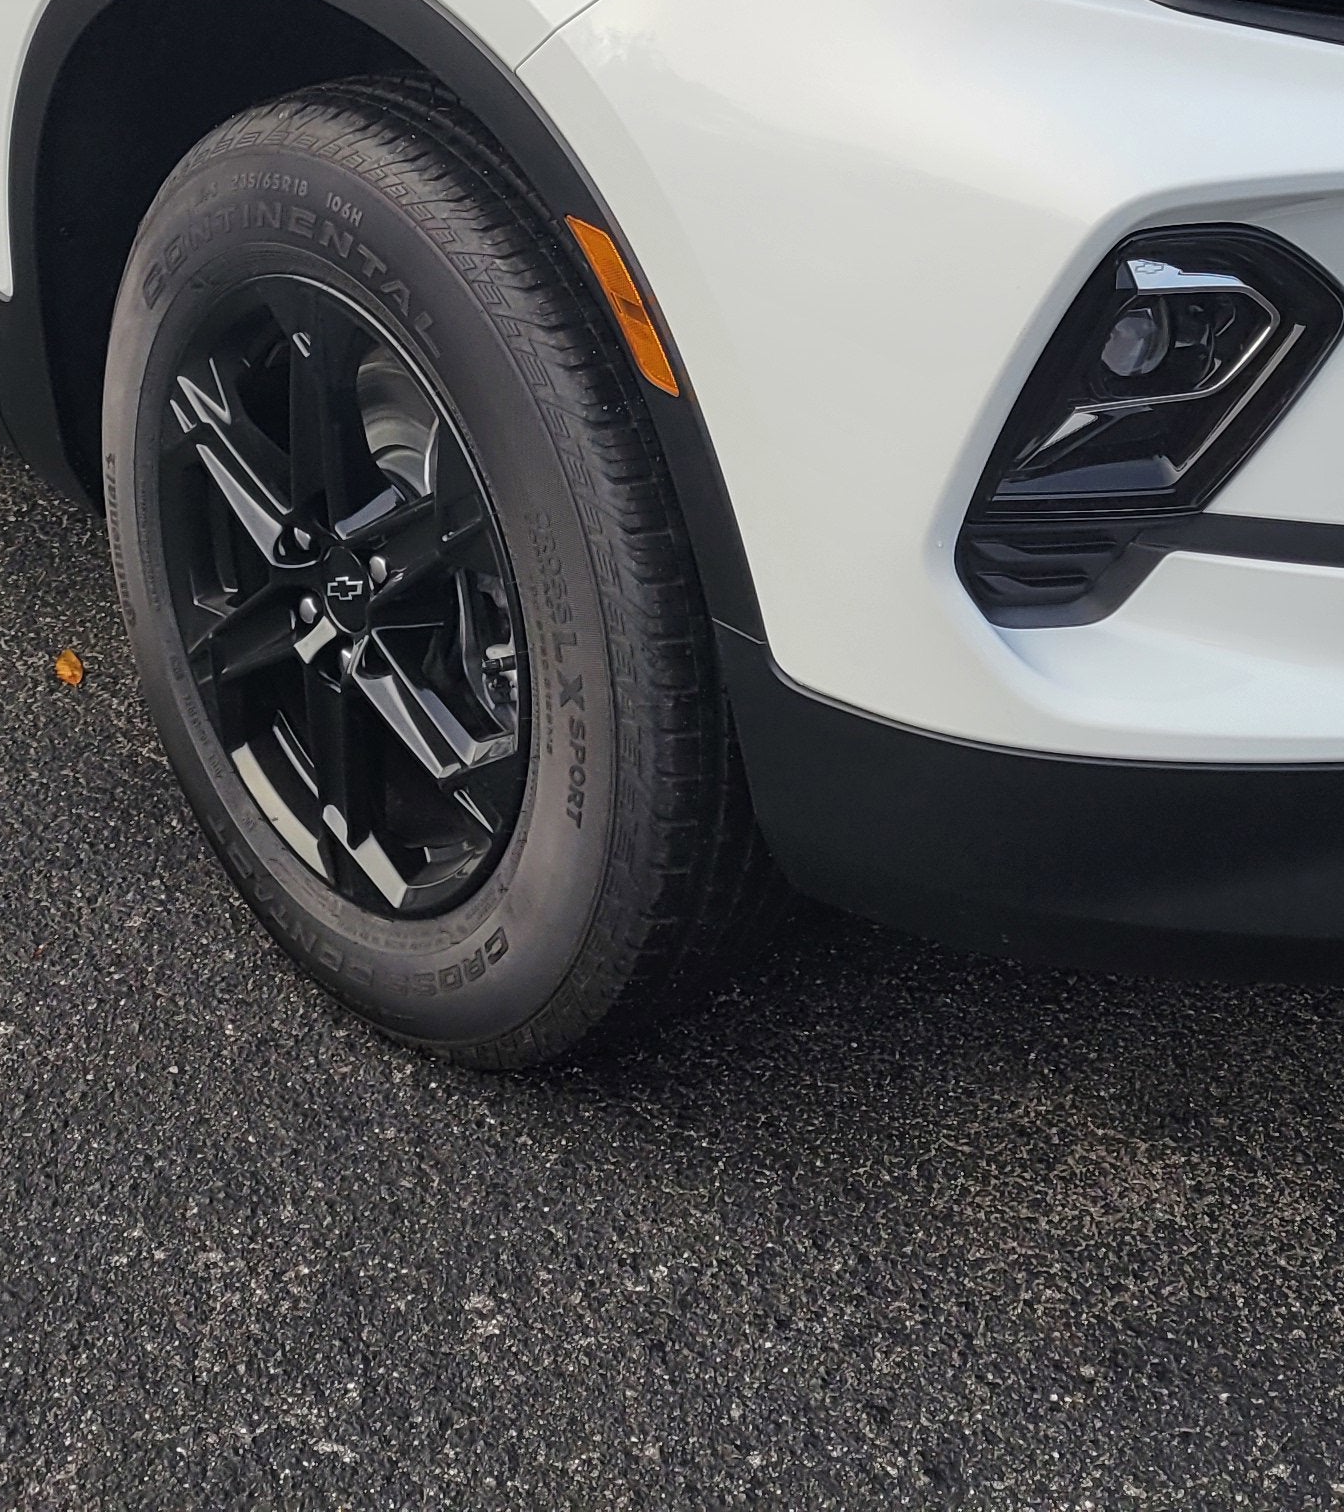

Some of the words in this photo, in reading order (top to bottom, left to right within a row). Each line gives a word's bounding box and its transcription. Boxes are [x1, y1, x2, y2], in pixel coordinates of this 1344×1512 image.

[324, 191, 363, 227] 106H
[140, 200, 444, 360] CONTINENTAL
[565, 715, 587, 830] SPORT
